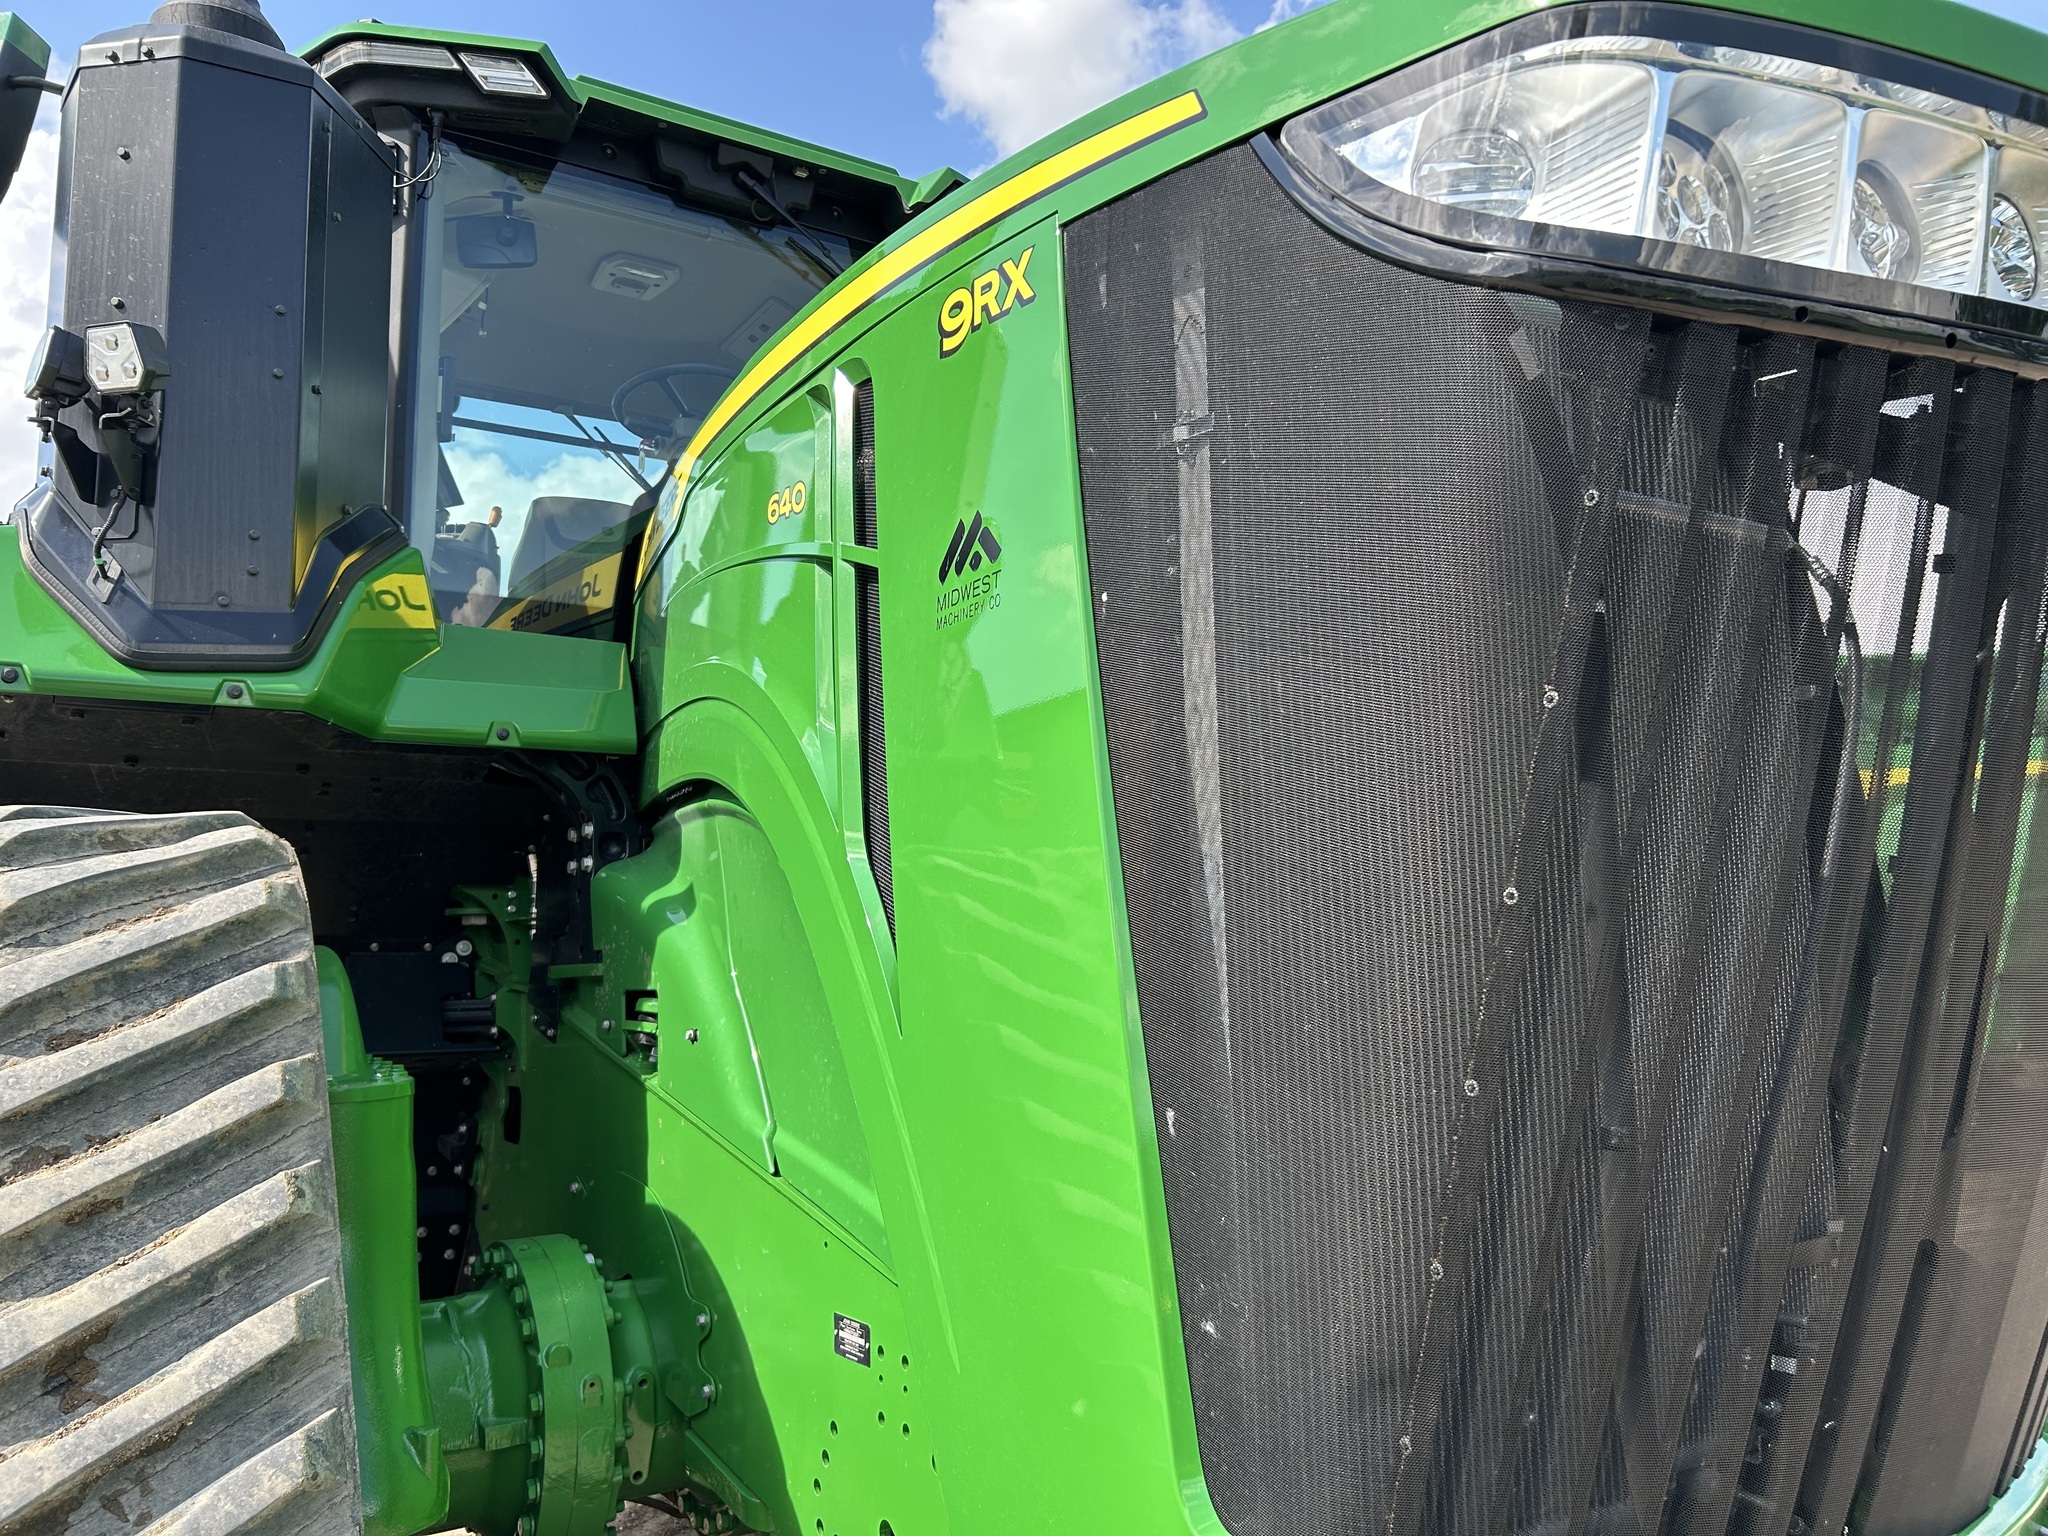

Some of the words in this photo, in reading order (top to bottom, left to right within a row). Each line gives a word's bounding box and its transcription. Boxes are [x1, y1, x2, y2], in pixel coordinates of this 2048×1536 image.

[938, 244, 1037, 360] 9RX
[767, 480, 806, 525] 640
[936, 569, 1002, 614] MIDWEST
[936, 599, 986, 631] MACHINERY
[988, 593, 1001, 610] CO
